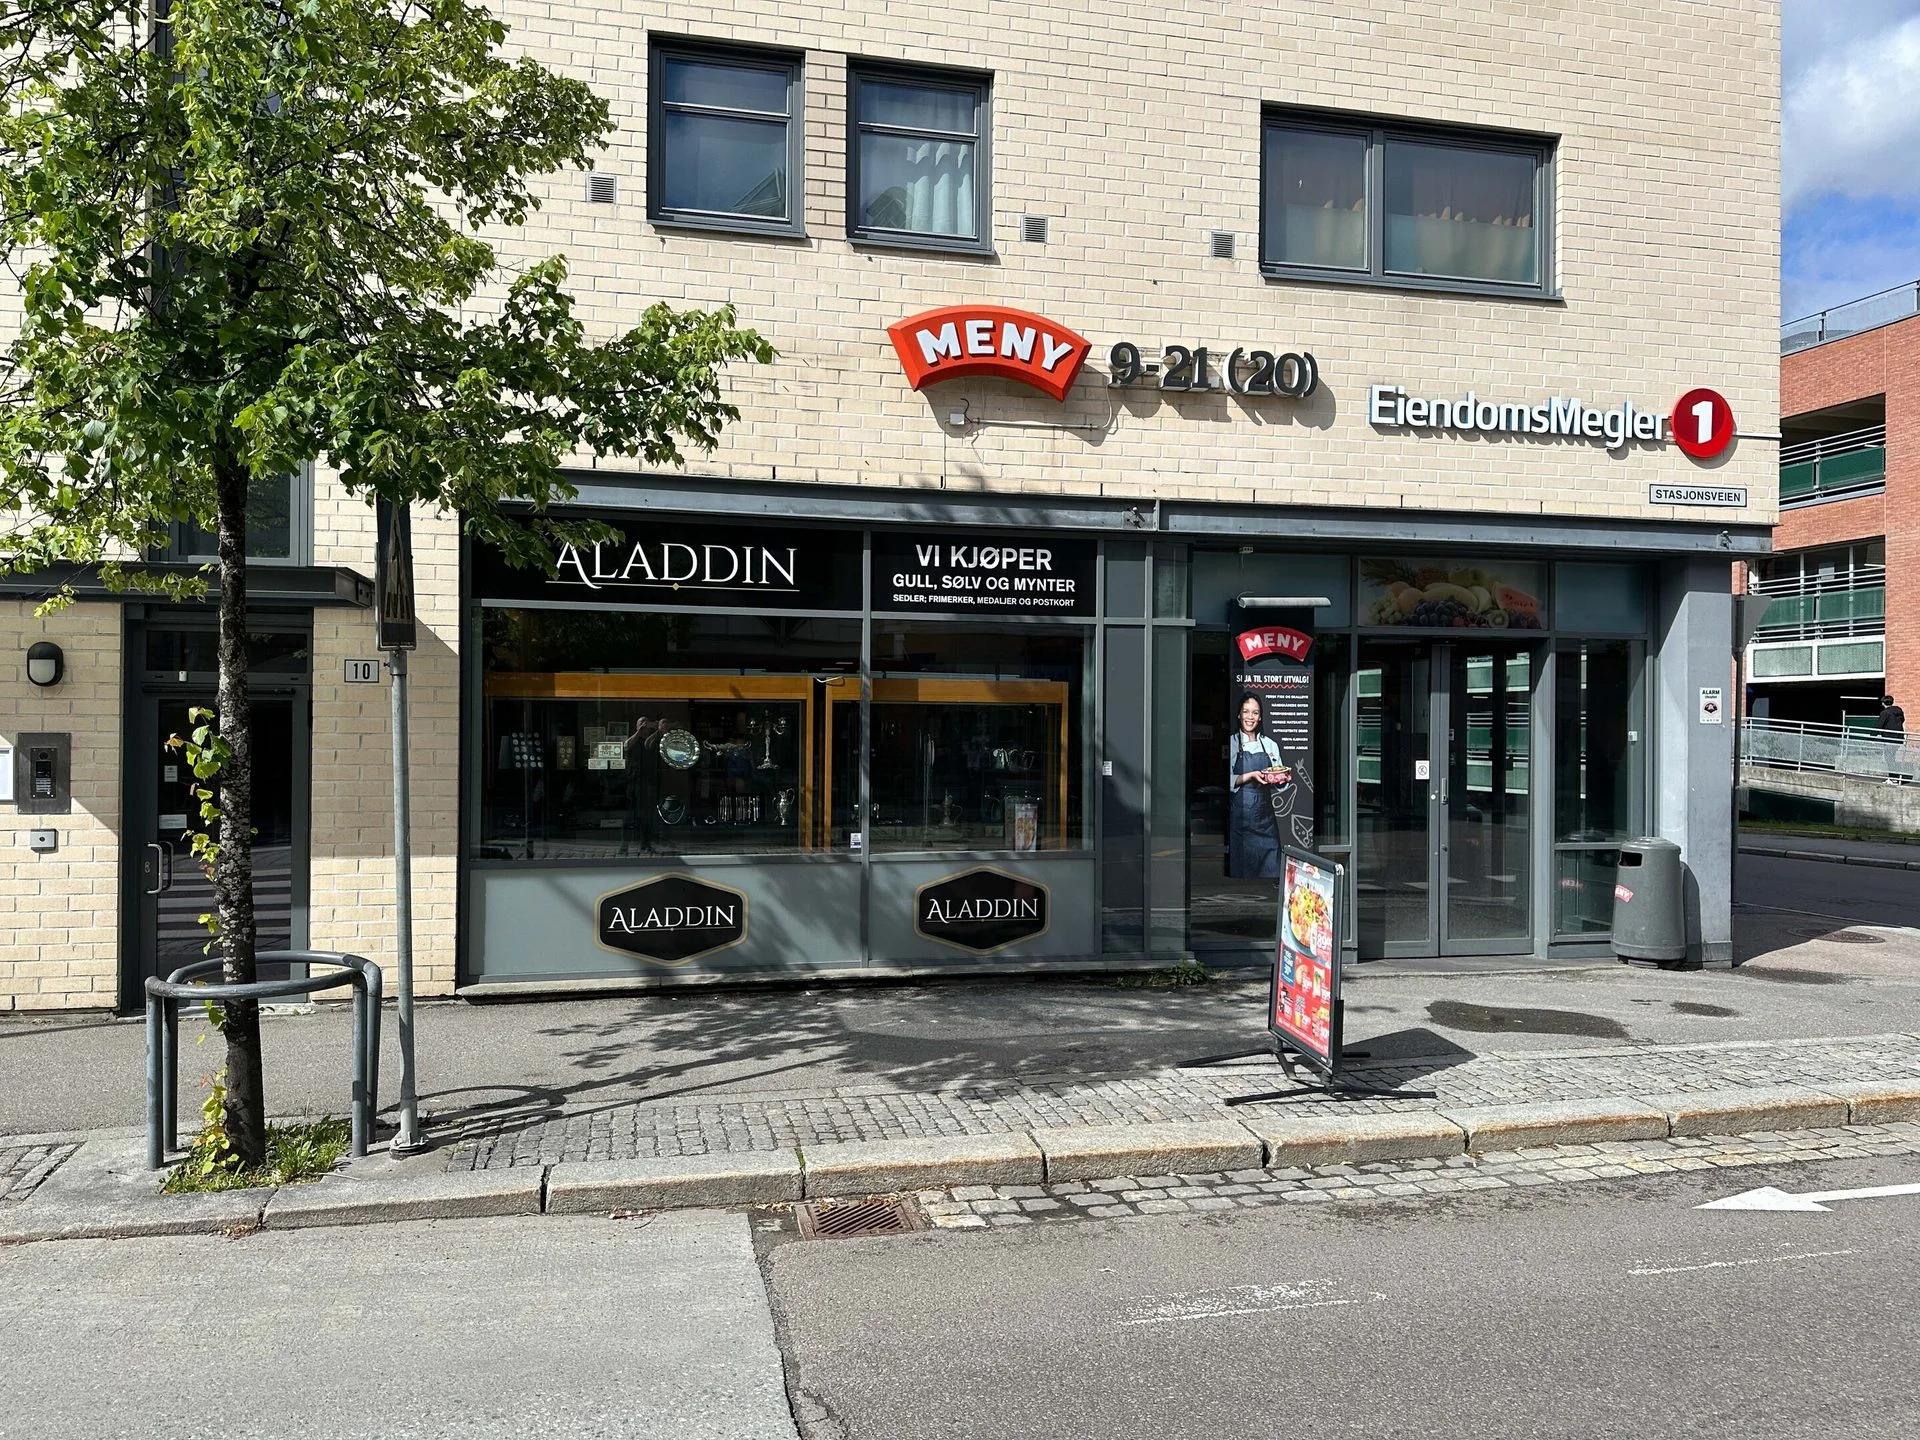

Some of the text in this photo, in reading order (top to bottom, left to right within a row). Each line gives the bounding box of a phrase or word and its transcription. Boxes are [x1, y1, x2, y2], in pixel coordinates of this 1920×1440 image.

[916, 319, 1073, 371] MENY
[1110, 341, 1319, 398] 9-21 (20)
[1370, 384, 1713, 449] EiendomsMegler 1
[1655, 488, 1741, 502] STASJONSVEIEN
[555, 541, 798, 589] ALADDIN
[916, 545, 1052, 571] VI KJØPER
[893, 574, 1076, 592] GULL, SØLV OG MYNTER
[928, 595, 976, 605] FRIMERKER,
[977, 597, 1017, 605] MEDALJER
[1019, 598, 1031, 606] OG
[1033, 599, 1075, 607] POSTKORT
[1245, 632, 1304, 651] MENY
[353, 662, 371, 681] 10
[1244, 675, 1252, 683] JA
[1253, 675, 1262, 683] TIL
[1263, 675, 1282, 683] STORT
[1284, 675, 1309, 684] UTVALG!
[608, 905, 735, 934] ALADDIN
[926, 898, 1039, 924] ALADDIN
